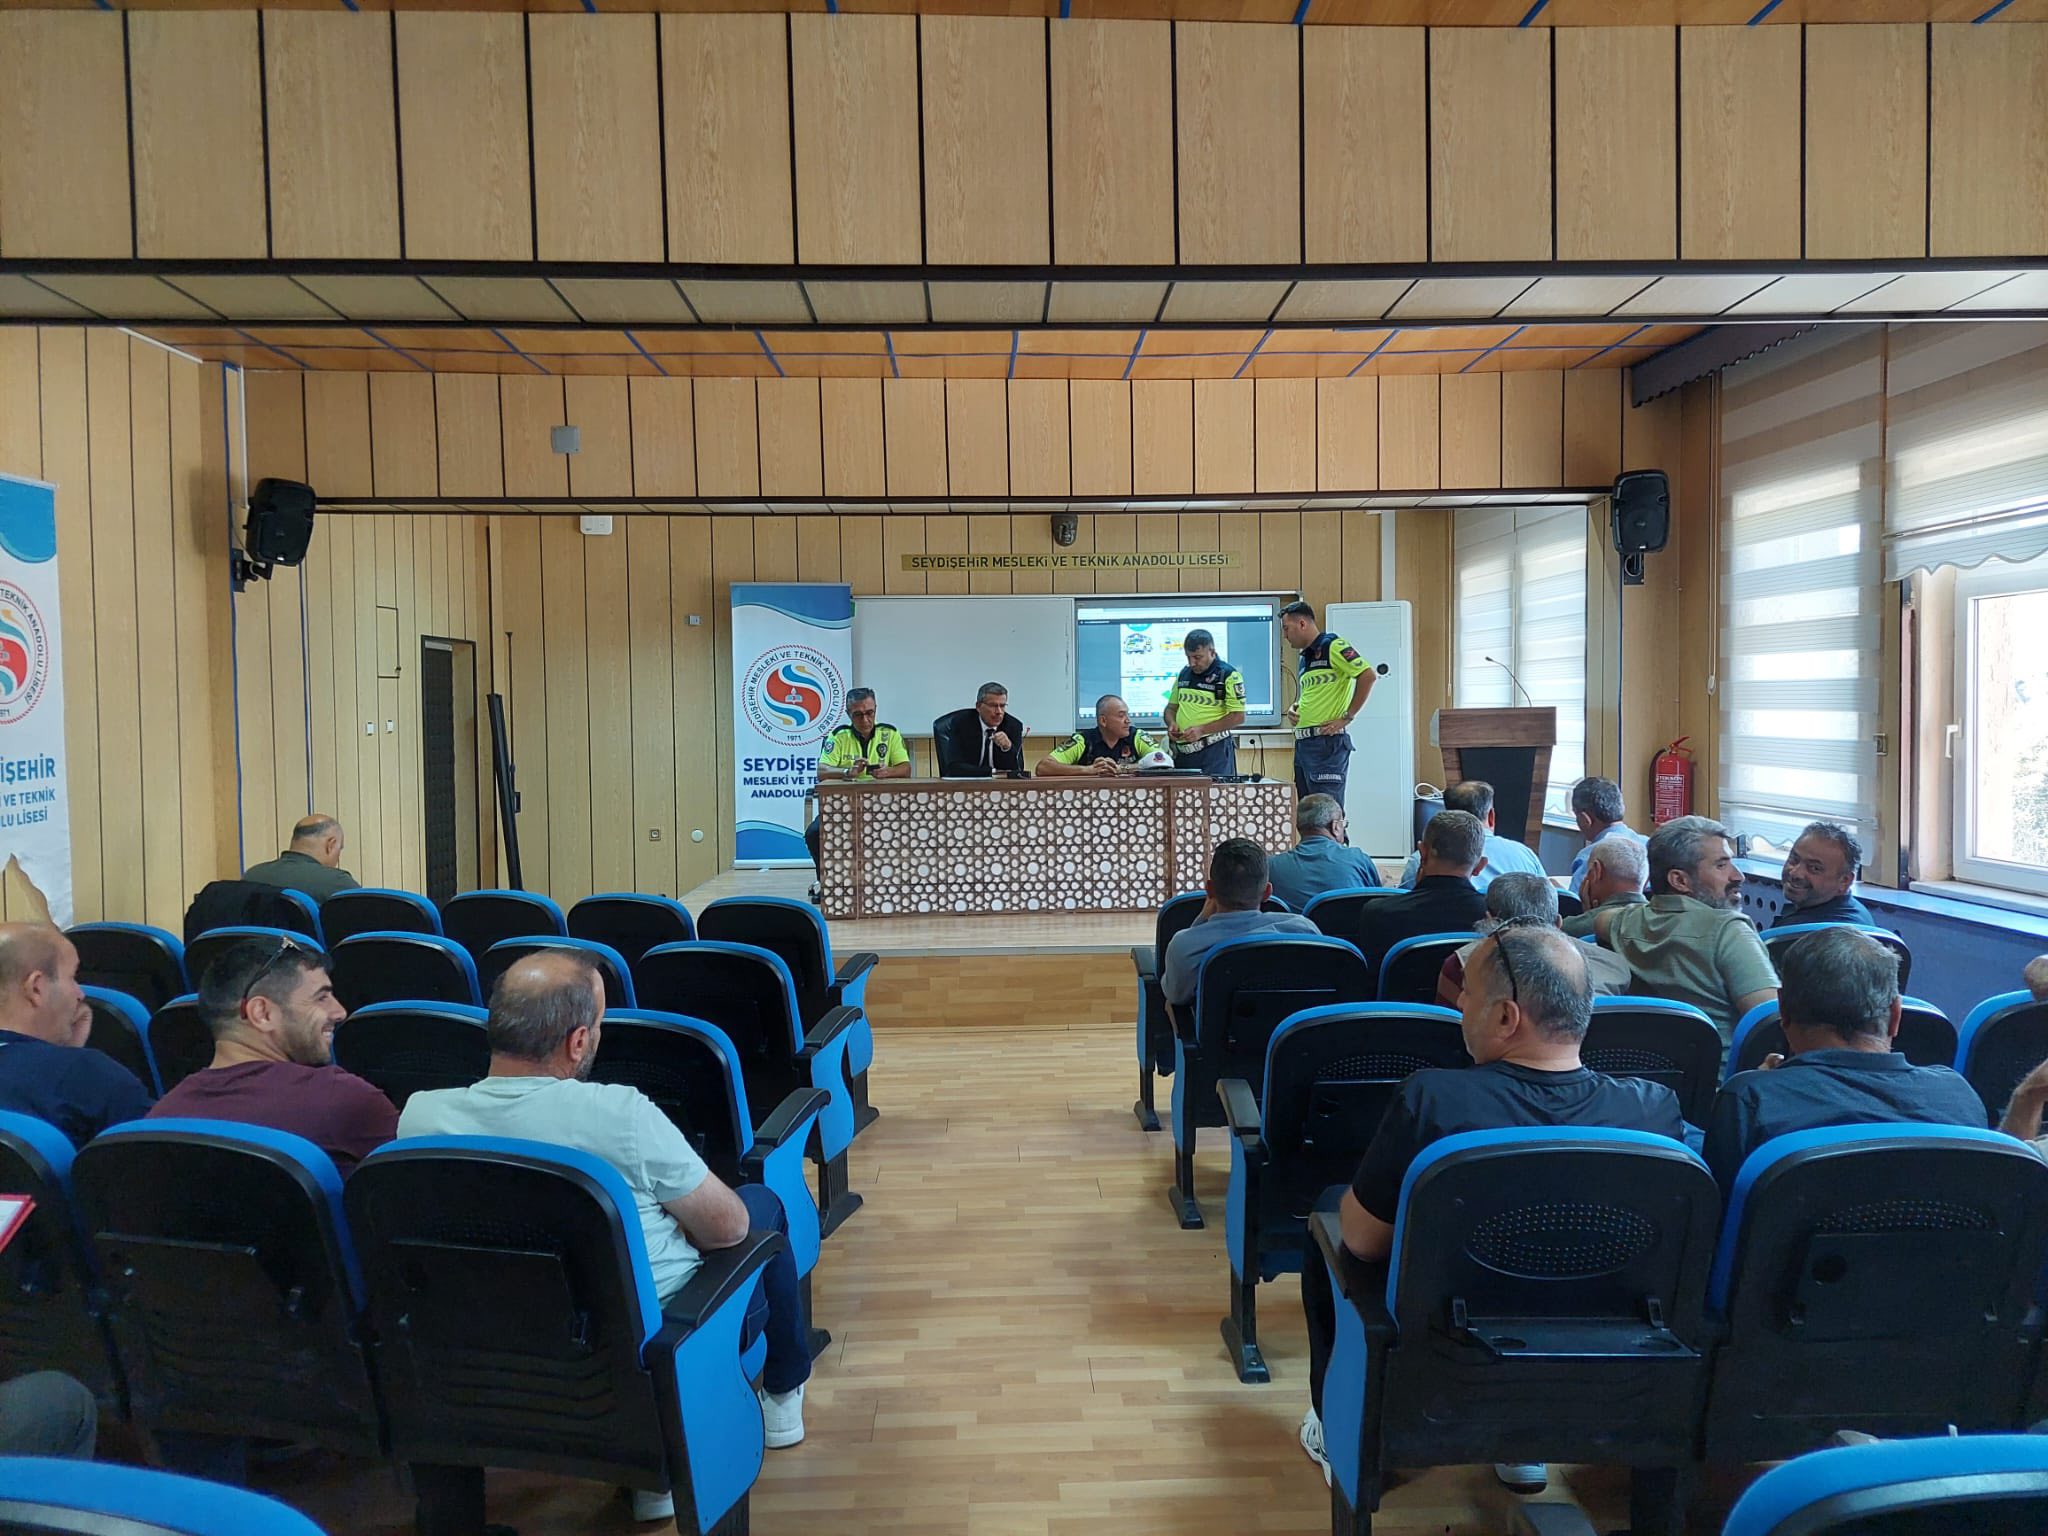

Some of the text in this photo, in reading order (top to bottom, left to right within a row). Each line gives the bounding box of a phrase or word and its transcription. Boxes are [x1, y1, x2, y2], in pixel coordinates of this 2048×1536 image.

[1052, 555, 1067, 567] VE
[1122, 554, 1185, 566] ANADOLU
[27, 613, 44, 668] ANADOLU
[750, 653, 779, 685] MESLEKİ
[780, 651, 792, 659] VE
[794, 650, 825, 668] TEKNİK
[823, 667, 840, 707] ANADOLU
[743, 754, 820, 775] SEYDİŞE
[743, 774, 789, 786] MESLEKİ
[791, 776, 805, 785] VE
[3, 794, 17, 807] VE
[18, 786, 56, 805] TEKNİK
[751, 788, 805, 798] ANADOLU
[16, 805, 48, 826] LİSESİ
